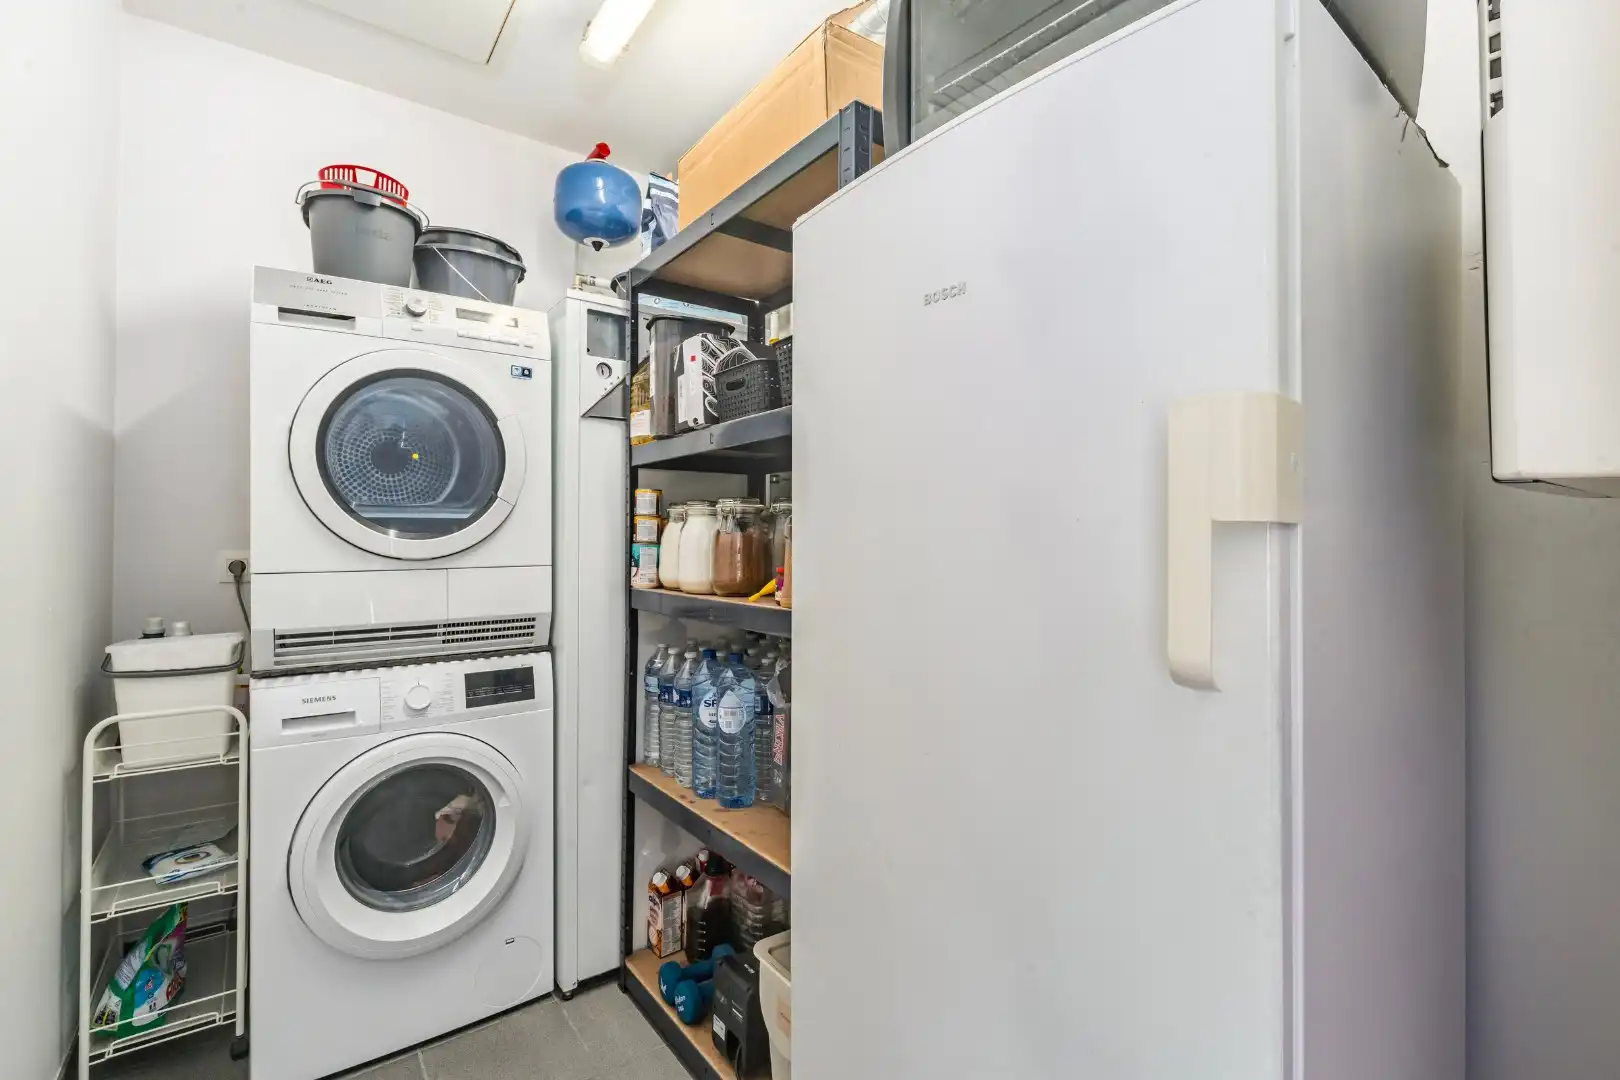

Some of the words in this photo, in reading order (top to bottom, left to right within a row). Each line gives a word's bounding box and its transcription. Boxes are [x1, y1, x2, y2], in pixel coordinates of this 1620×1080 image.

[313, 277, 333, 285] AEG
[923, 281, 967, 306] BOSCH
[301, 695, 337, 704] SIEMENS
